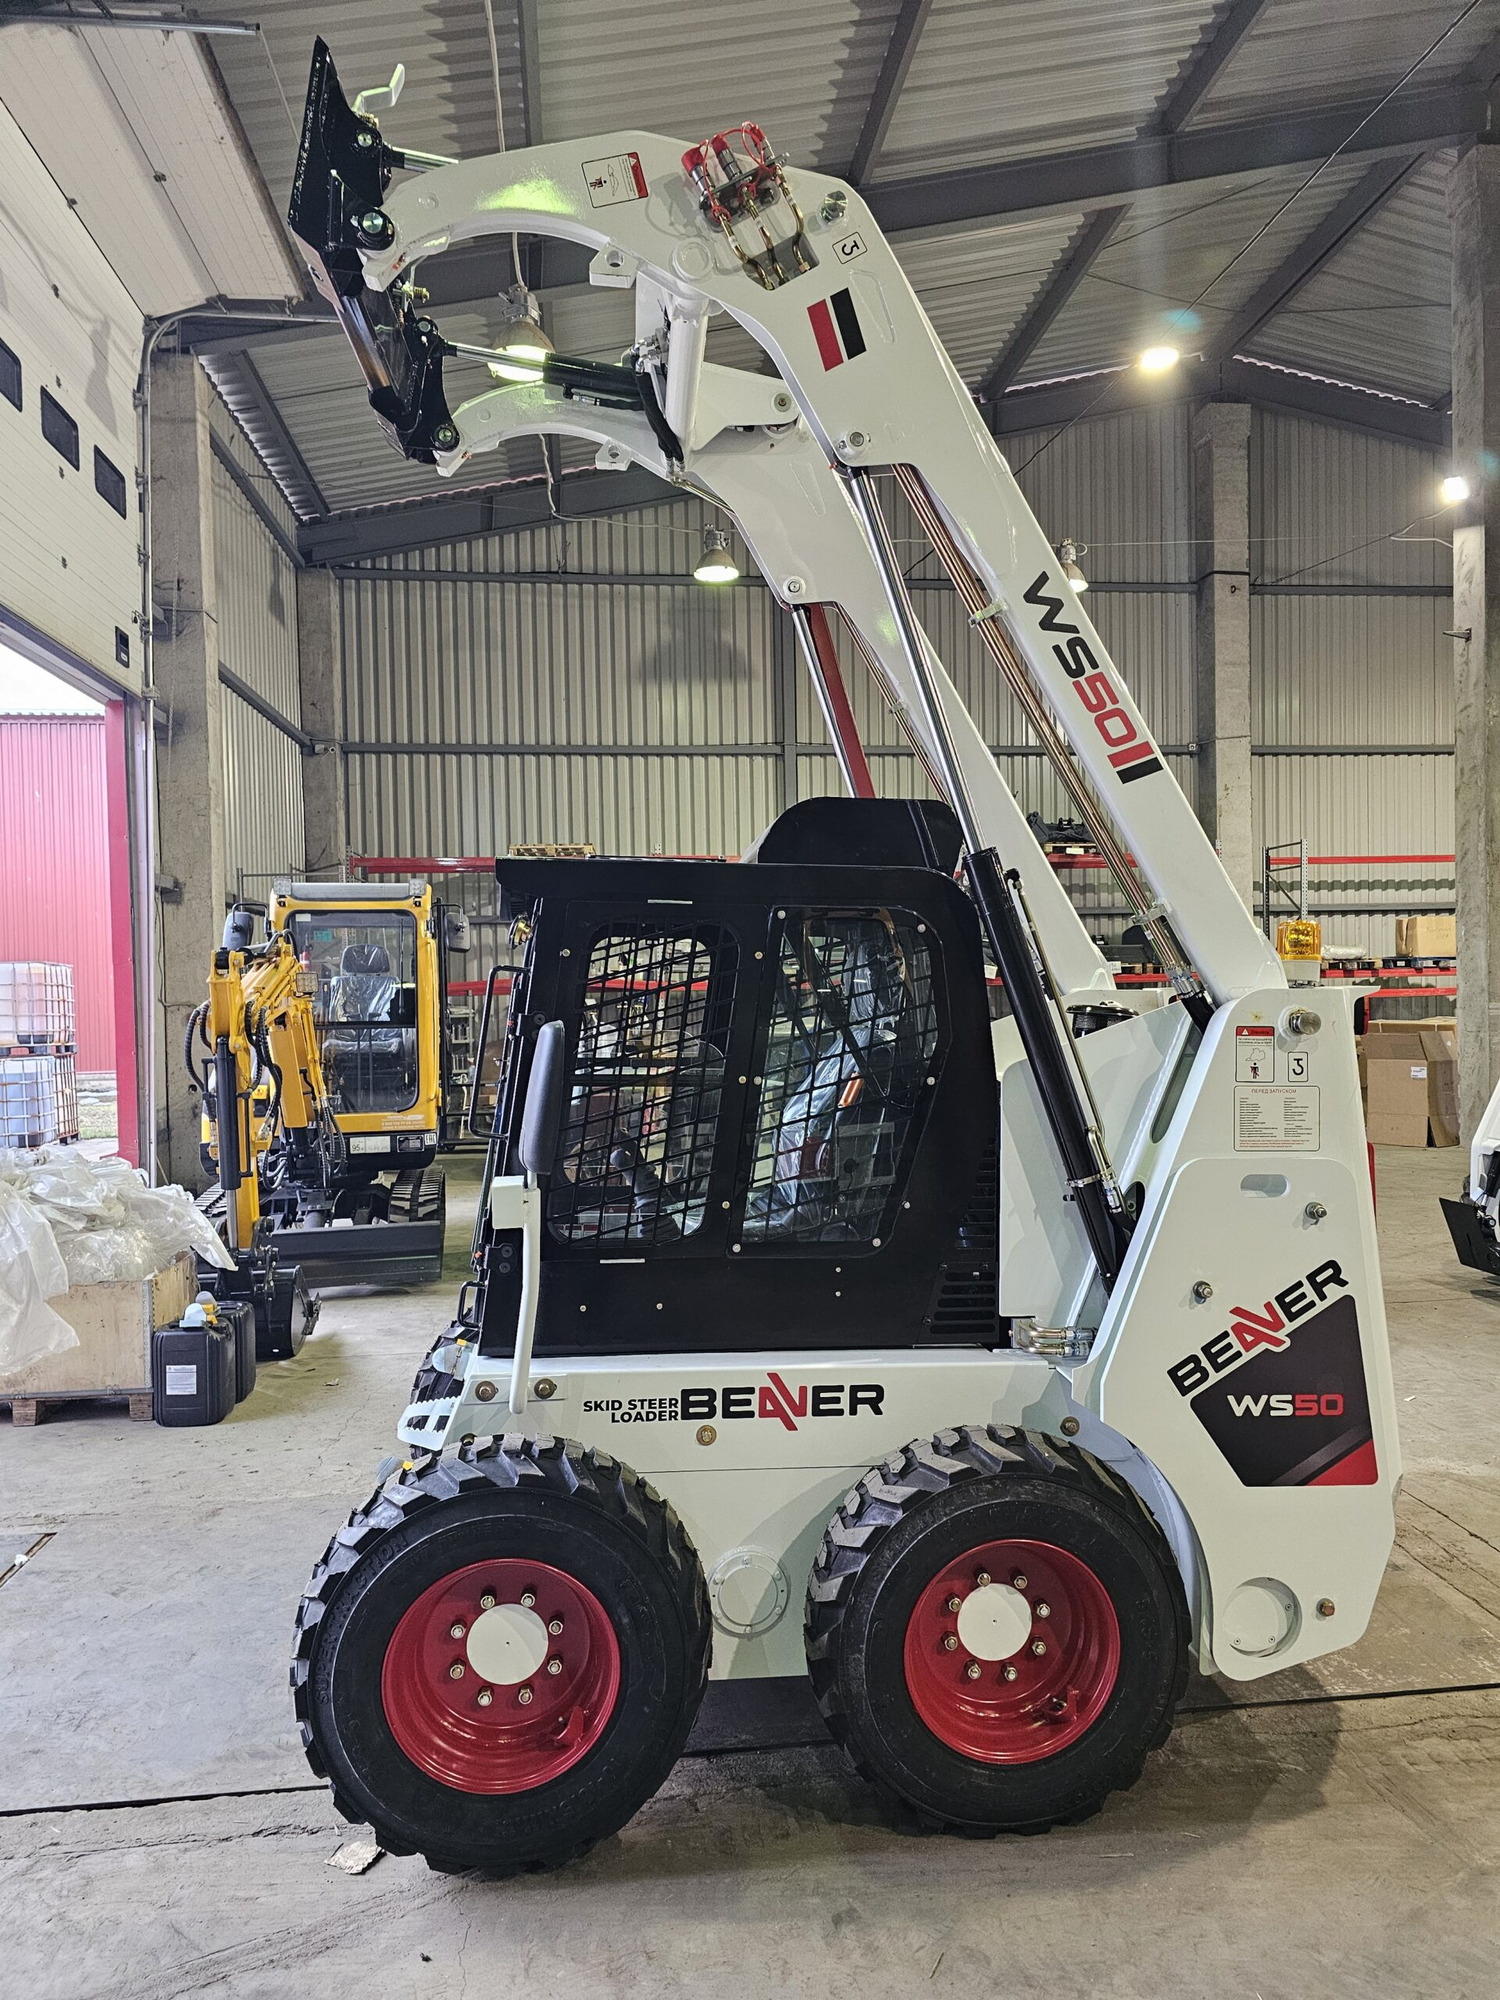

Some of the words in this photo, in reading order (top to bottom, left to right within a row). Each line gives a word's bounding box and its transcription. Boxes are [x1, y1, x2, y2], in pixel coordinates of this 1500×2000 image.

[1023, 571, 1138, 748] WS50
[1167, 1259, 1350, 1397] BEAVER
[583, 1399, 622, 1413] SKID
[627, 1397, 679, 1411] STEER
[680, 1372, 885, 1431] BEAVER
[610, 1410, 679, 1424] LOADER
[1227, 1394, 1344, 1417] WS50
